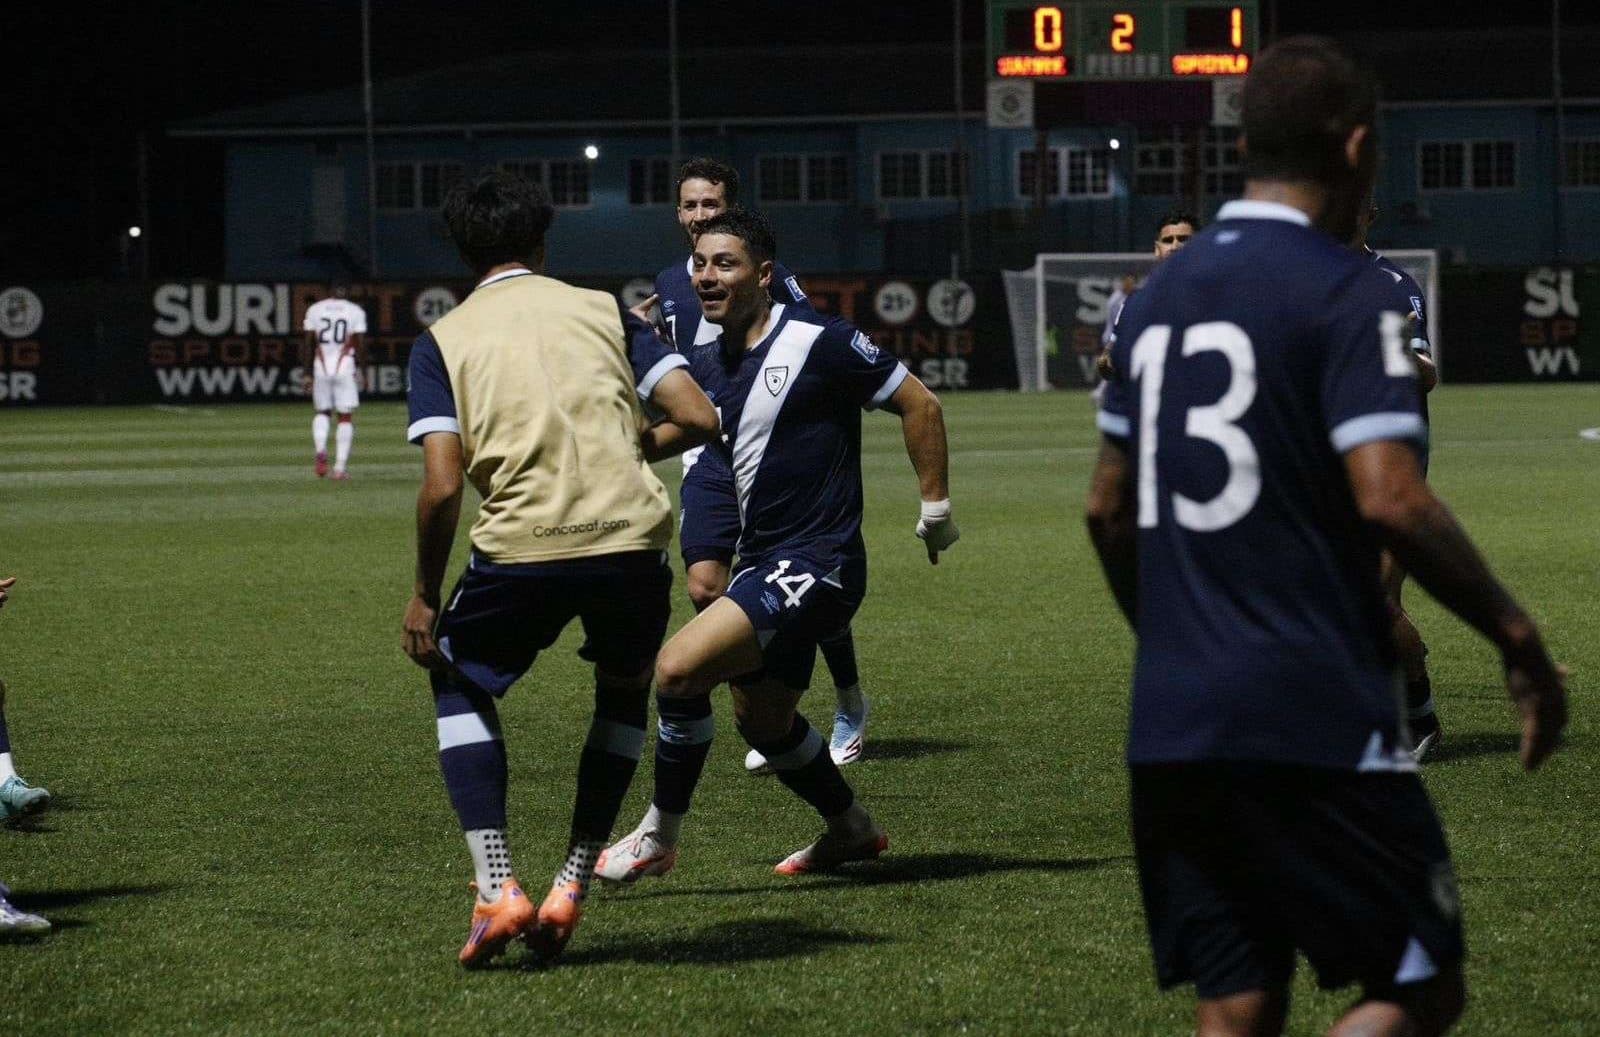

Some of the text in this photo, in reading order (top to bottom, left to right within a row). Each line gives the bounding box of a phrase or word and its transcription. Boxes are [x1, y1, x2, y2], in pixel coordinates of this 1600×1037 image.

[1034, 7, 1062, 51] 0
[1111, 13, 1134, 51] 2
[1231, 8, 1242, 48] 1
[153, 281, 407, 335] SURIBT
[319, 318, 347, 343] 20
[1130, 320, 1262, 533] 13
[532, 519, 631, 538] Concacaf.com
[764, 560, 816, 608] 14
